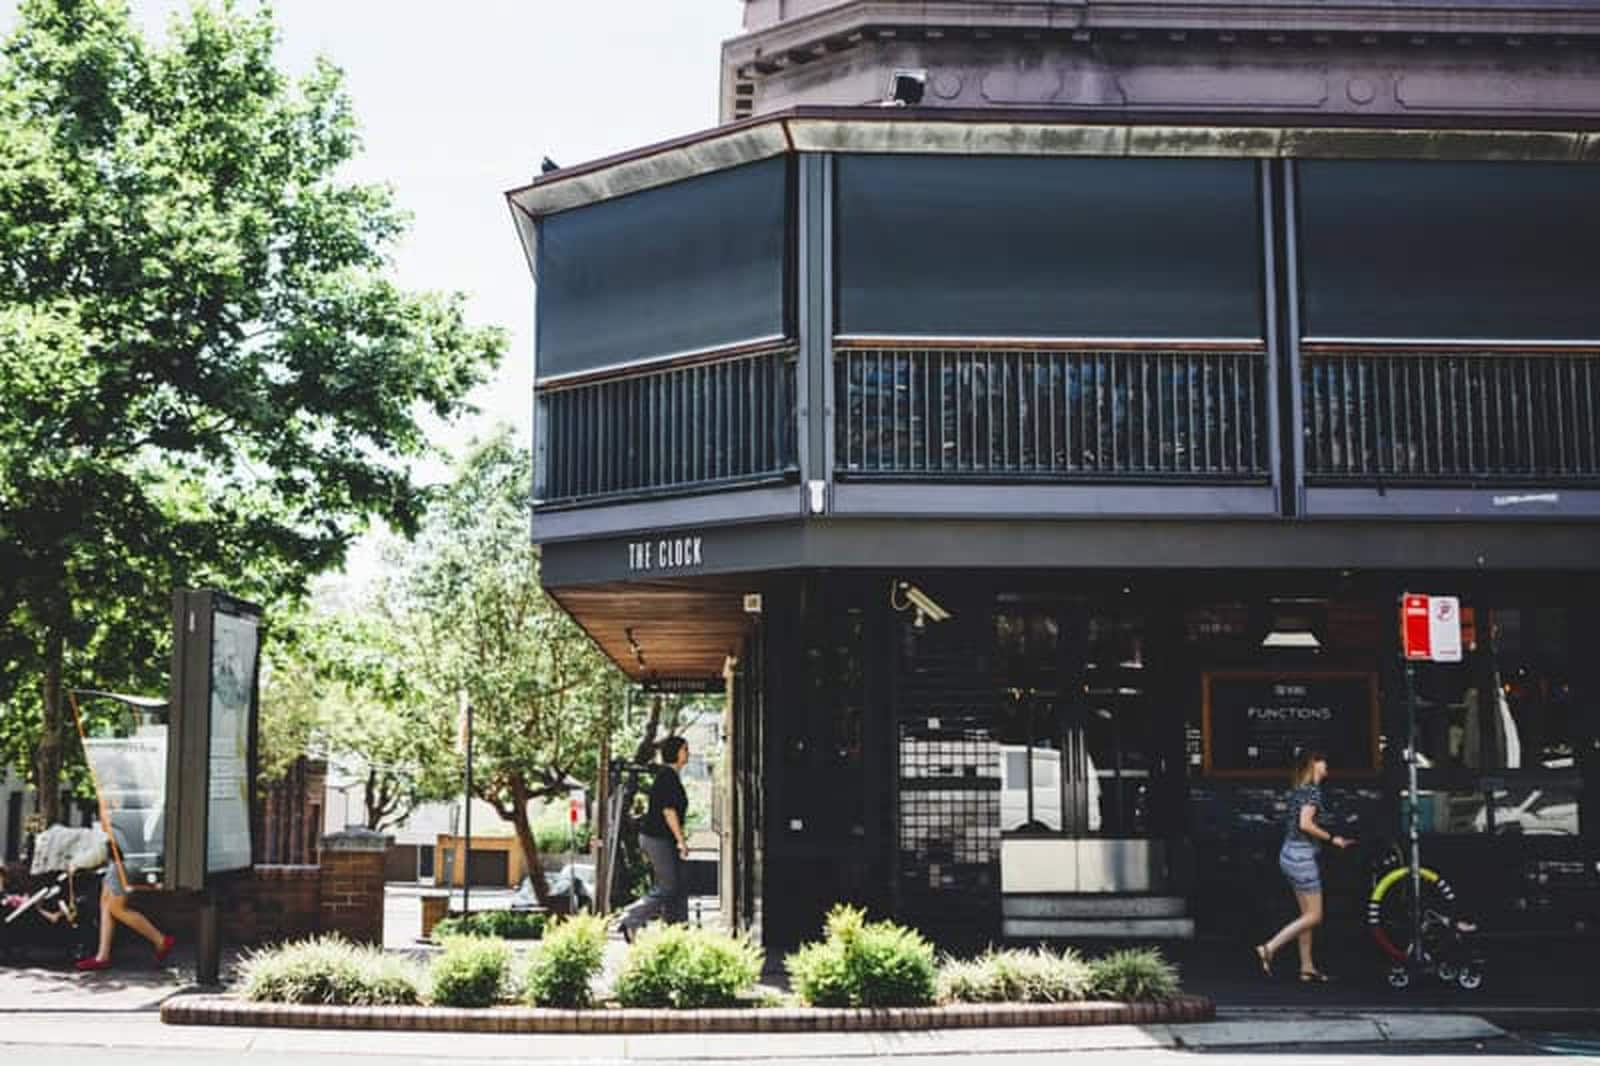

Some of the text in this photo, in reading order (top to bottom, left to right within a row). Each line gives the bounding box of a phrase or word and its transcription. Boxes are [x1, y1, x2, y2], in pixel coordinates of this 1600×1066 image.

[629, 538, 702, 569] THE CLOCK
[1248, 707, 1332, 720] FUNCTIONS
